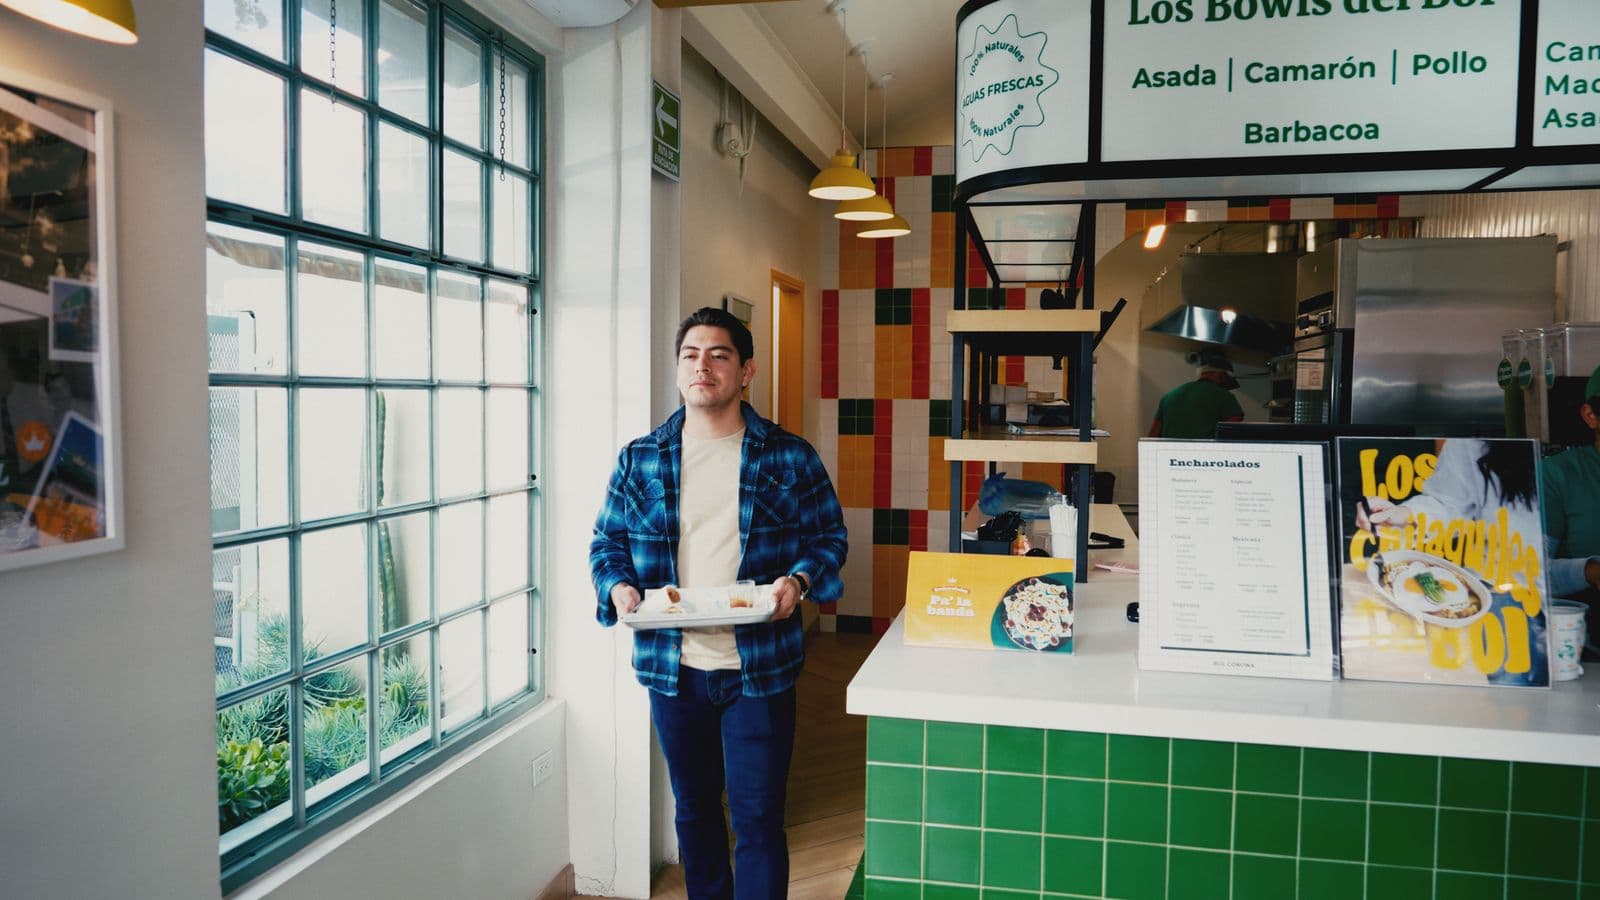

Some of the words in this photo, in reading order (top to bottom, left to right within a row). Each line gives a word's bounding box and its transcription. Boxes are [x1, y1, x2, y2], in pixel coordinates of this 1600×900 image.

[1128, 0, 1194, 25] Los
[969, 51, 985, 77] 100%
[985, 41, 1025, 63] Naturales
[1131, 63, 1216, 89] Asada
[1244, 56, 1376, 84] Camarón
[1412, 50, 1487, 76] Pollo
[987, 74, 1044, 97] FRESCAS
[983, 103, 1025, 137] Naturales
[1542, 107, 1600, 129] Asa
[1244, 120, 1379, 144] Barbacoa
[1169, 458, 1261, 468] Encharolados
[1359, 448, 1438, 502] Los
